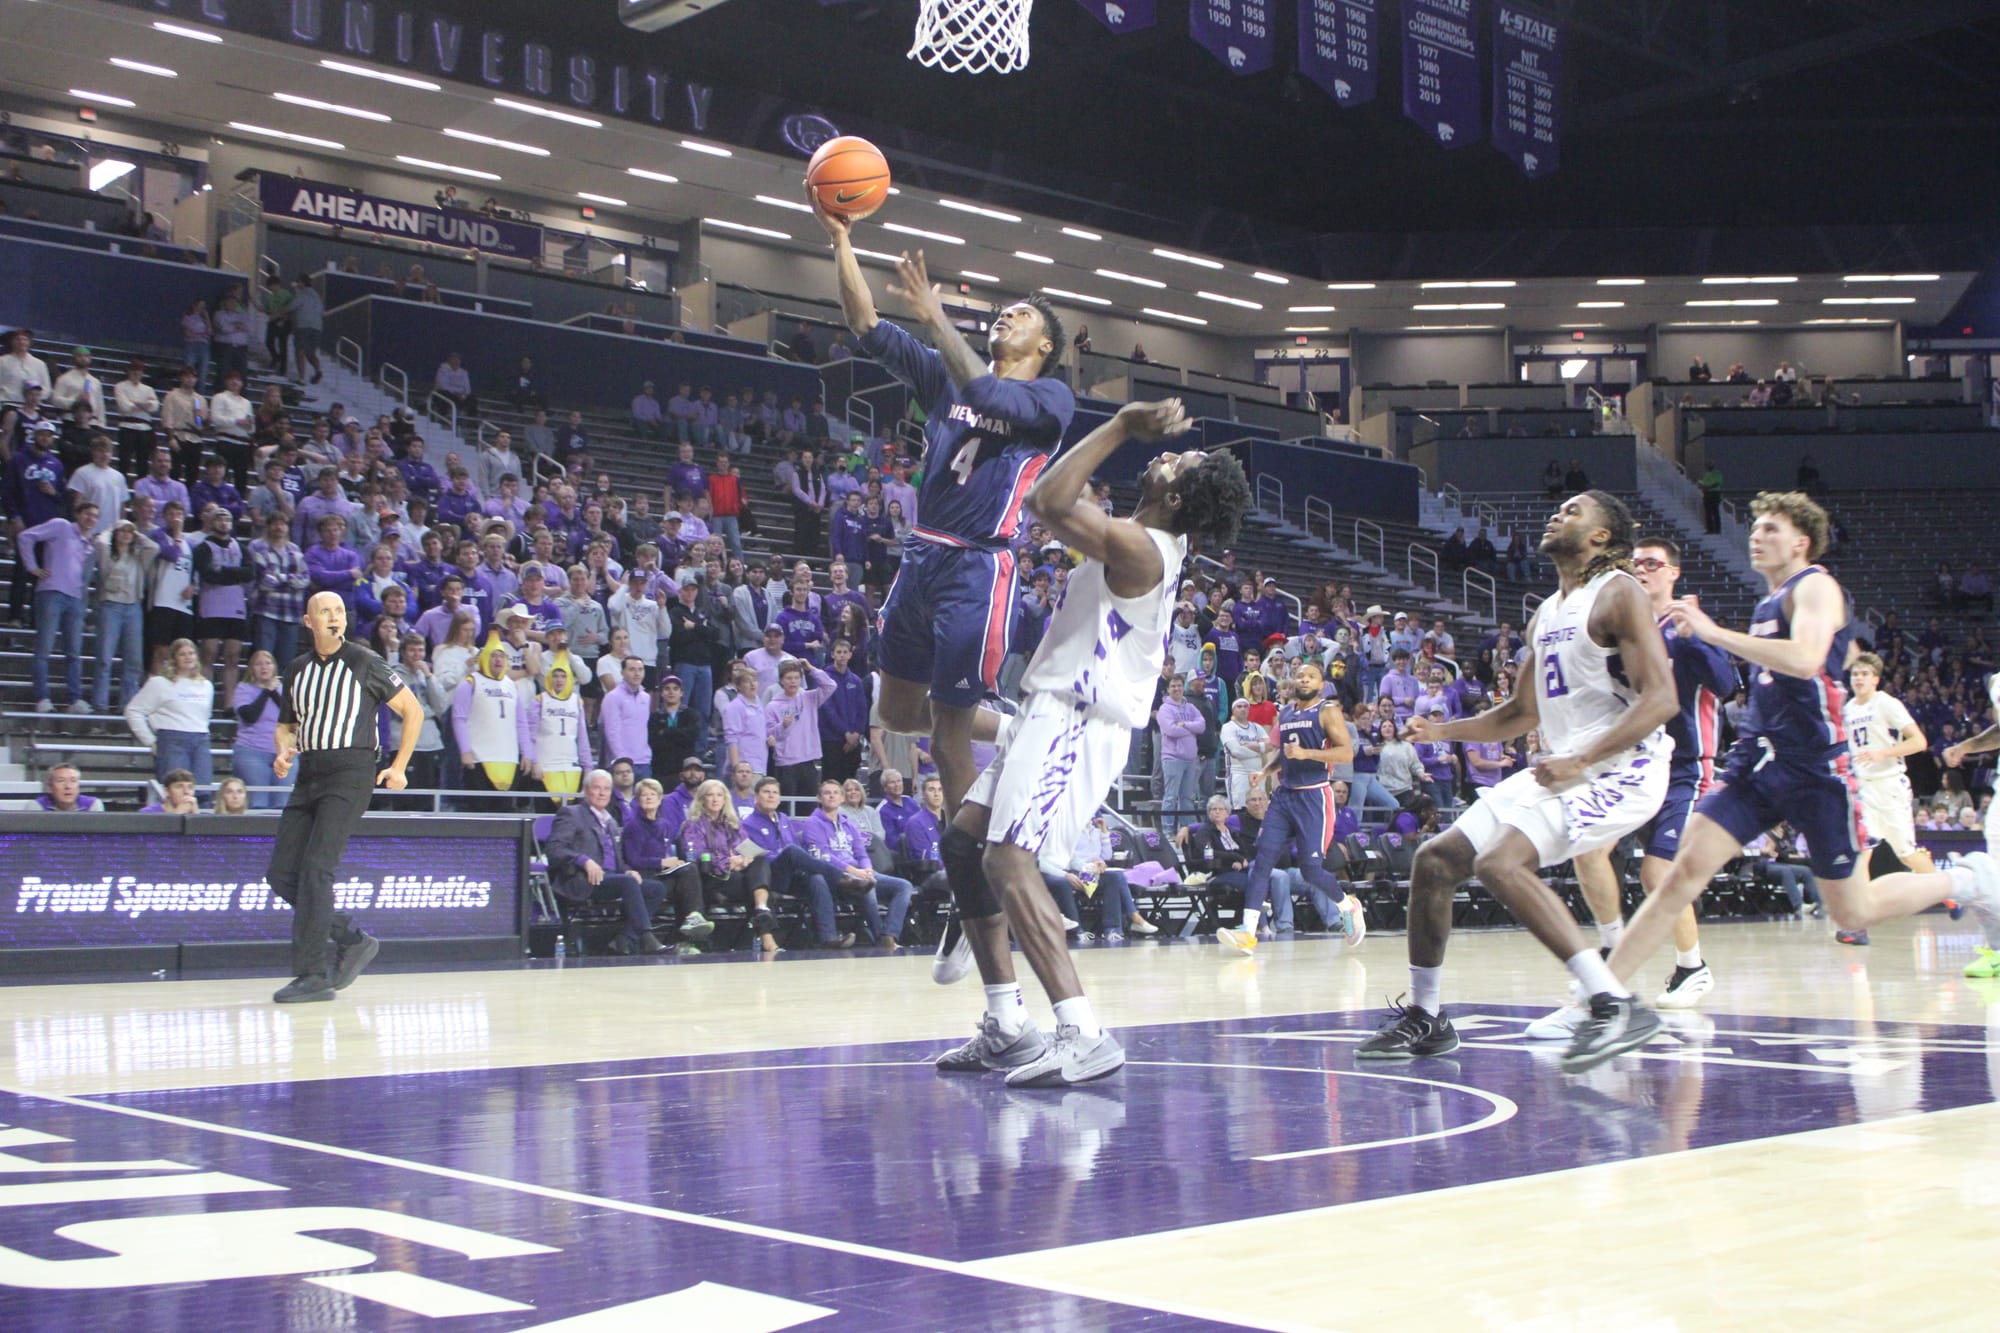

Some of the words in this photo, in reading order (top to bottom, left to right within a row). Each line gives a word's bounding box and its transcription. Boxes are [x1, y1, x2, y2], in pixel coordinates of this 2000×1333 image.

[1208, 9, 1231, 27] 1950
[1241, 4, 1265, 22] 1958
[1314, 12, 1335, 29] 1961
[1345, 7, 1366, 24] 1968
[1241, 20, 1266, 38] 1959
[1345, 22, 1367, 40] 1970
[1416, 11, 1467, 37] CONFERENCE
[1500, 8, 1557, 43] K-STATE
[1314, 28, 1337, 45] 1963
[1409, 20, 1475, 51] CHAMPIONSHIPS
[1315, 43, 1337, 61] 1964
[1346, 38, 1368, 55] 1972
[1417, 44, 1439, 59] 1977
[292, 0, 712, 131] UNIVERSITY
[1347, 54, 1369, 71] 1973
[1521, 49, 1538, 68] NIT
[1418, 74, 1440, 90] 2013
[1419, 89, 1441, 105] 2019
[1273, 348, 1288, 359] 22
[1314, 348, 1329, 359] 22
[948, 404, 1012, 436] NEWMAN
[951, 437, 982, 485] 4
[499, 700, 506, 719] 1
[560, 718, 567, 736] 1
[16, 877, 113, 912] Proud
[113, 877, 238, 918] Sponsor
[375, 876, 491, 908] Athletics
